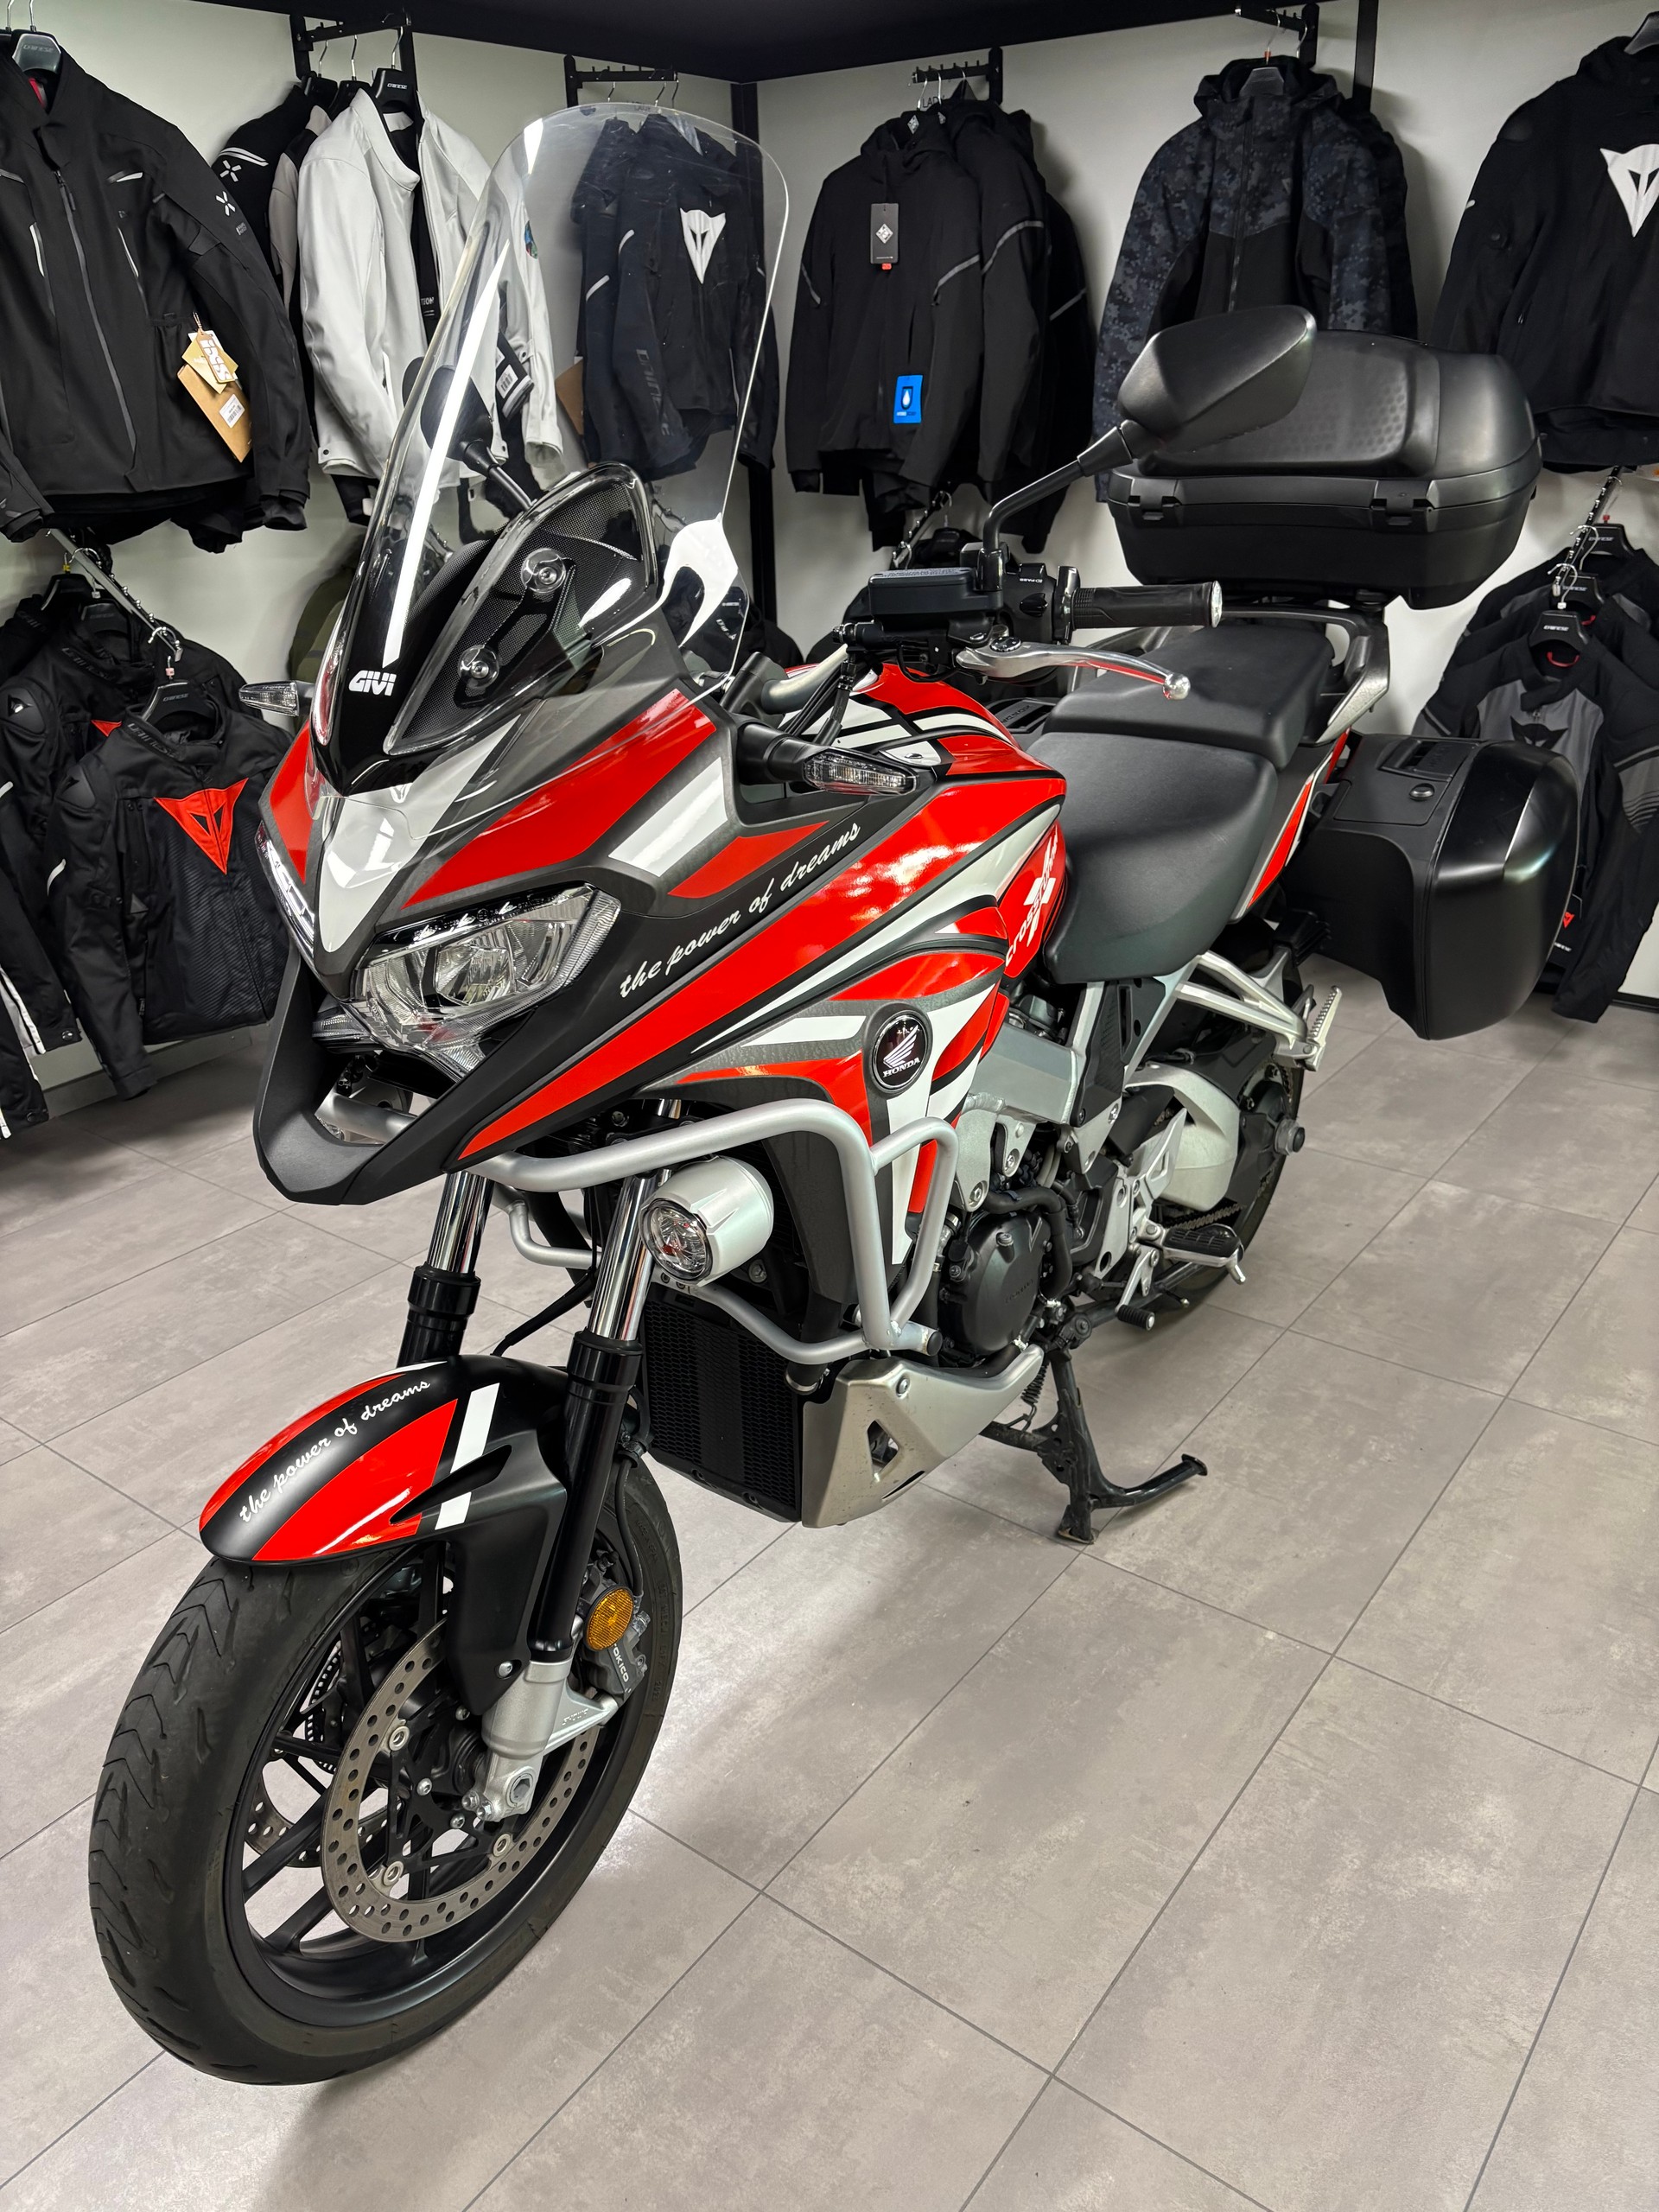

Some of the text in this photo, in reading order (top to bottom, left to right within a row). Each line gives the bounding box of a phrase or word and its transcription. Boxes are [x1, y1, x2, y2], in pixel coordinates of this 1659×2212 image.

[348, 670, 397, 696] GIVI
[620, 823, 862, 999] the power of dreams
[882, 1057, 921, 1078] HONDA
[239, 1380, 431, 1522] the power of dreams
[613, 1643, 629, 1682] OKICO
